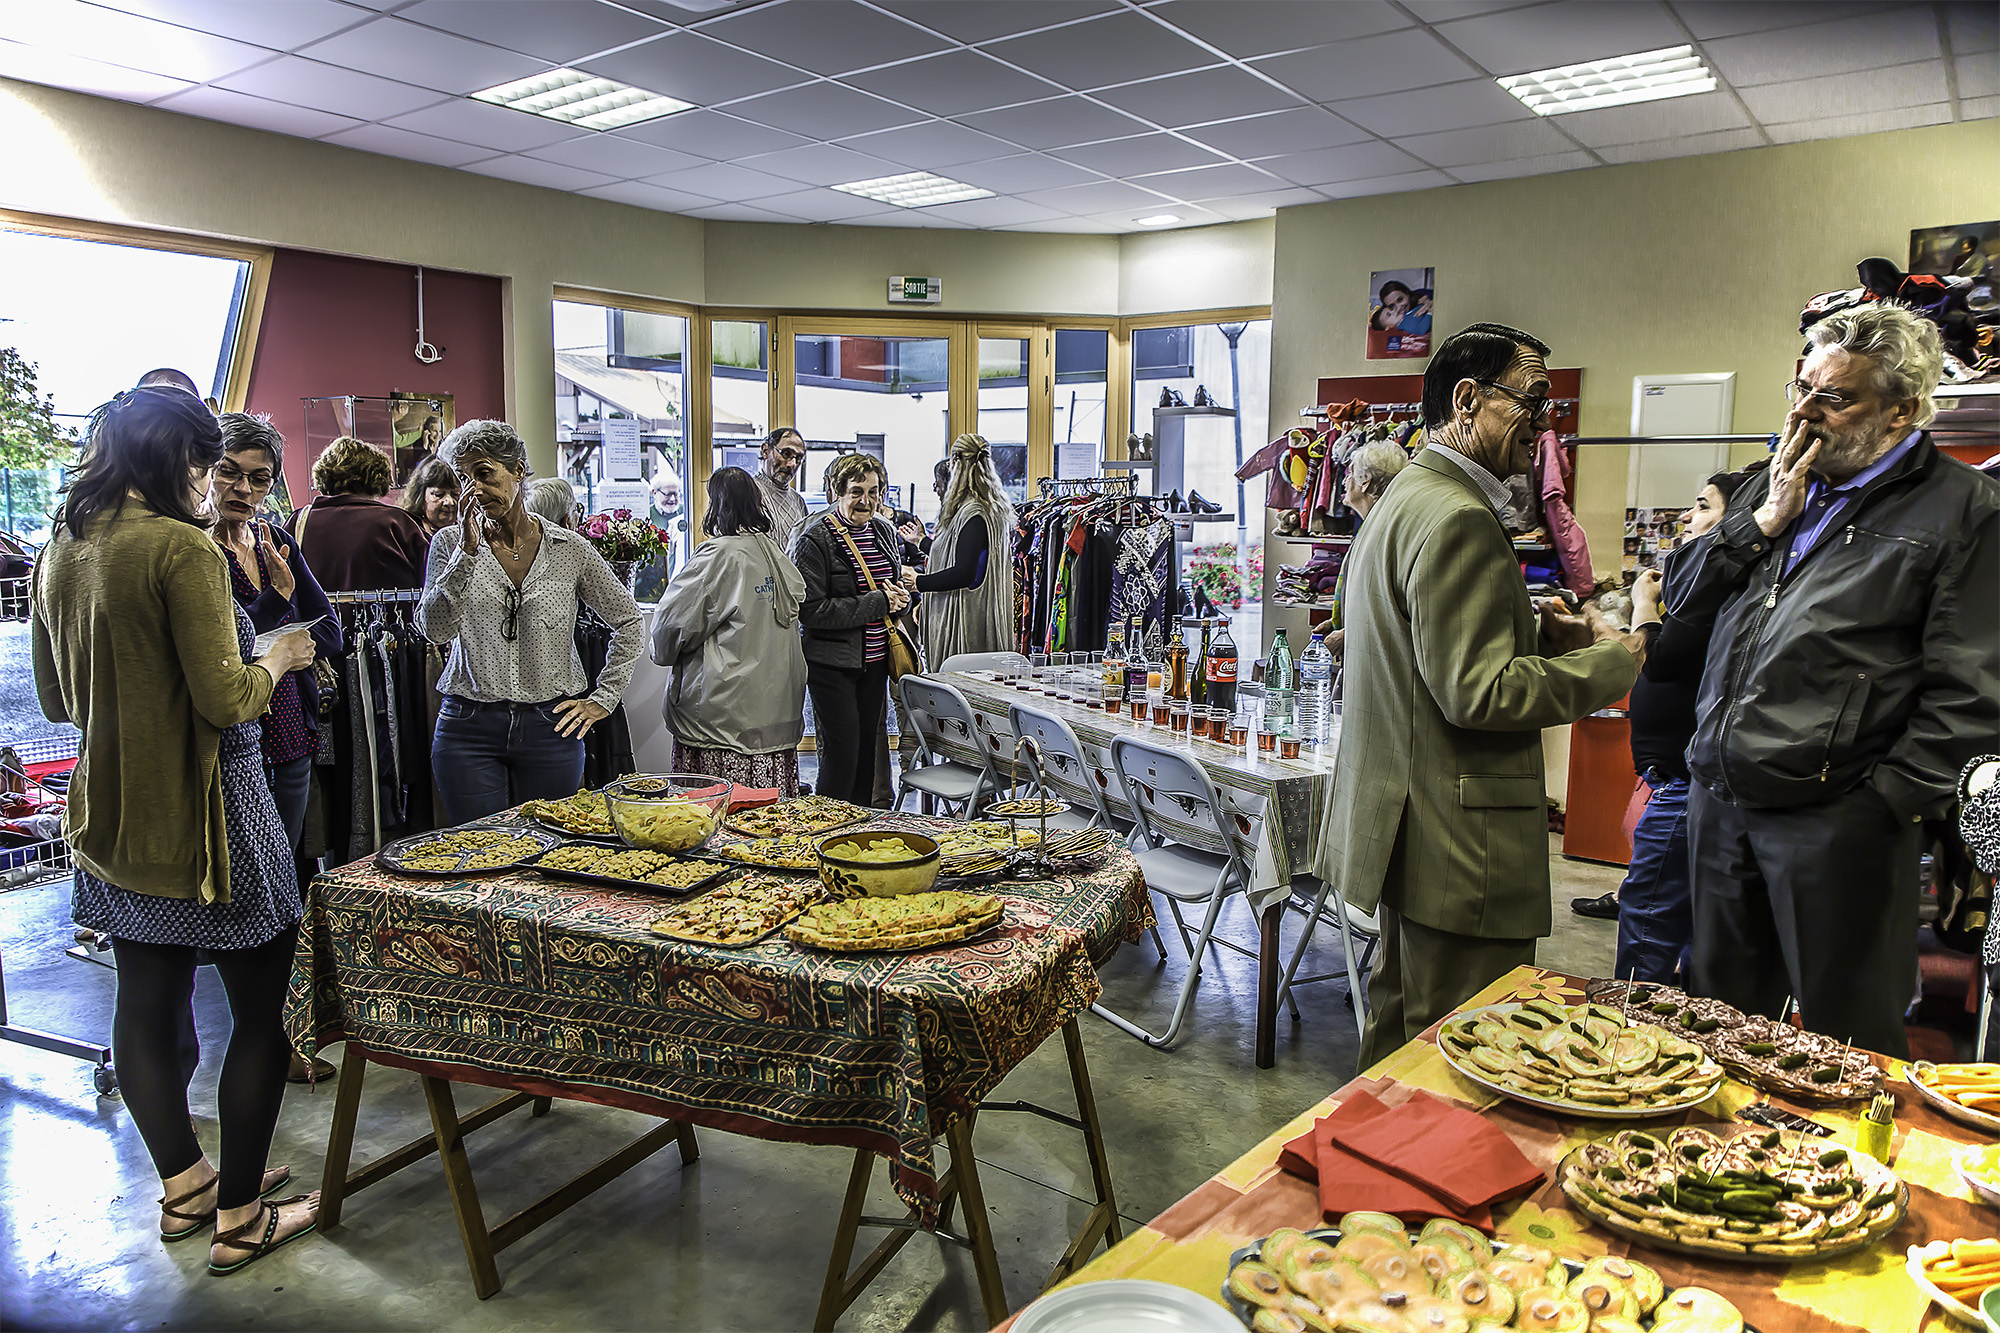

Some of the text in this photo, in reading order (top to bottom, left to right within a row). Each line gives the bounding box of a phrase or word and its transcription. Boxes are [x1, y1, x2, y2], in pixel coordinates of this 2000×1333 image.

[905, 282, 926, 294] SORTIE
[765, 576, 774, 585] SE
[754, 584, 774, 594] CATH
